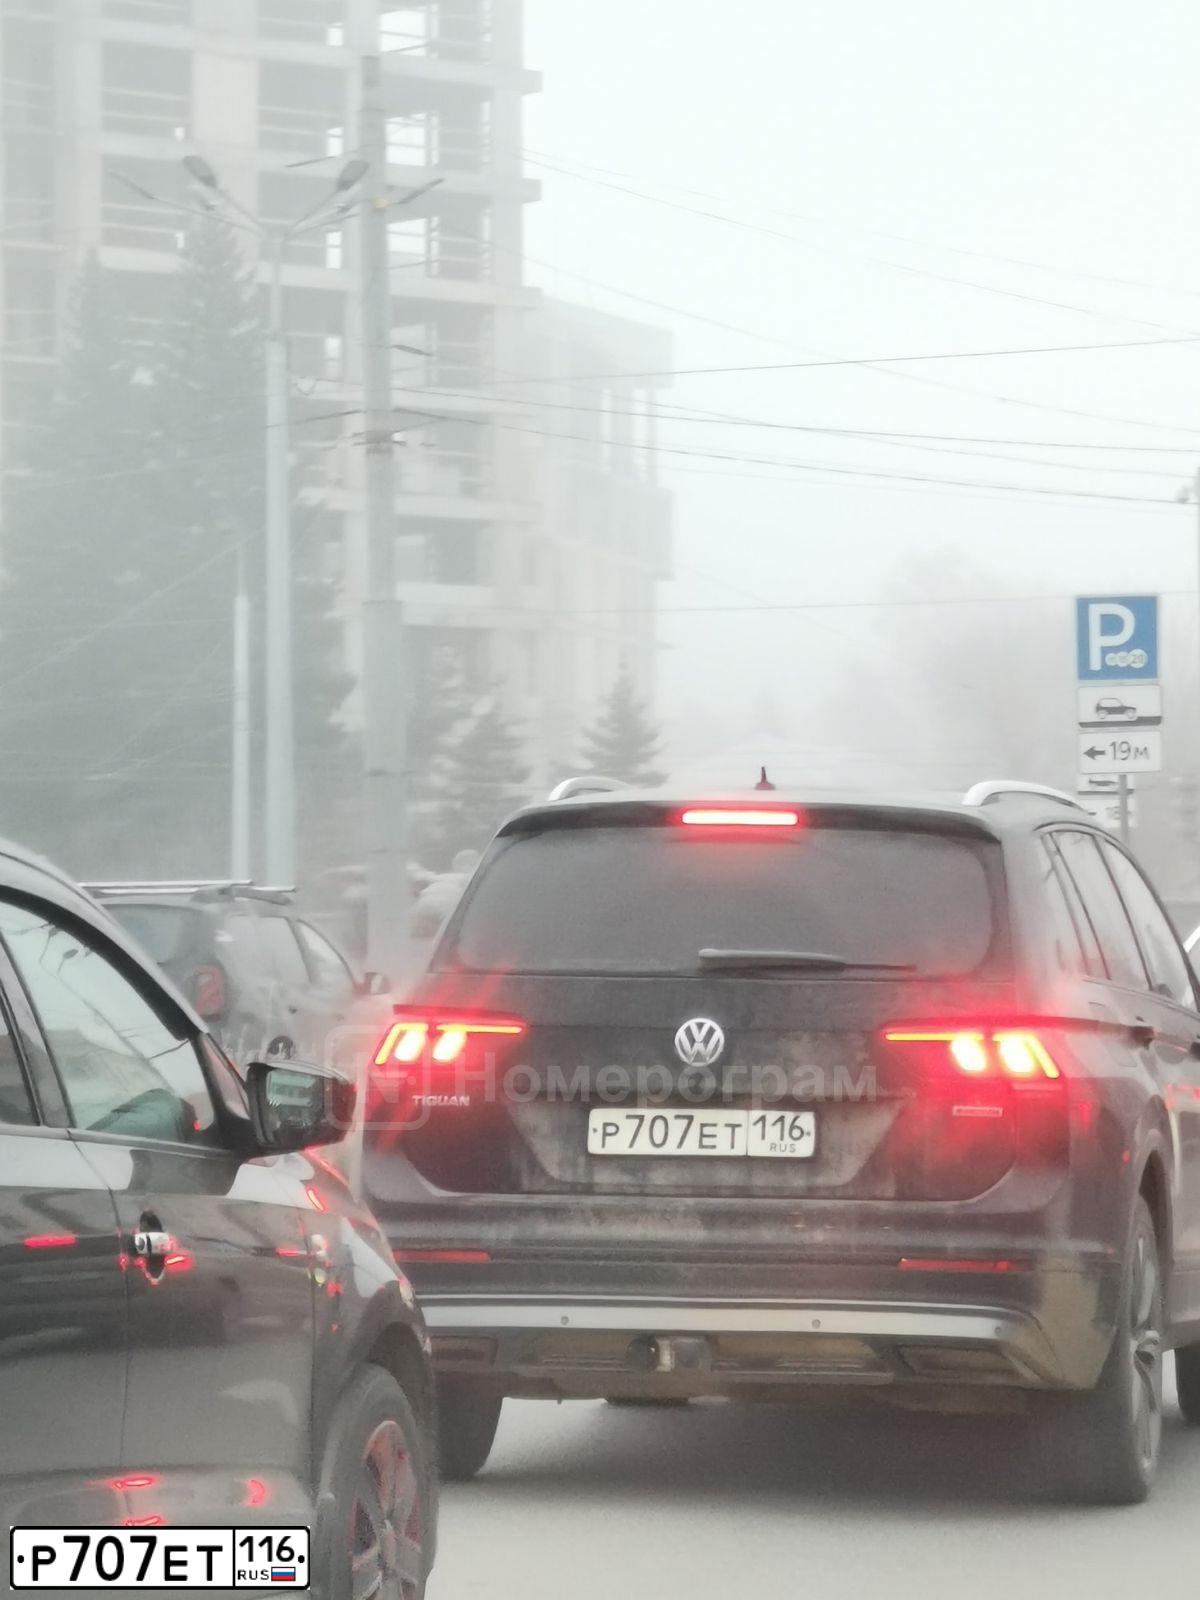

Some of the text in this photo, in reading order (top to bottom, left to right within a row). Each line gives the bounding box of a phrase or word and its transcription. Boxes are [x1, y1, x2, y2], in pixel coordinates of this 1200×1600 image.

[1088, 603, 1136, 671] P
[412, 1094, 470, 1106] TIGUAN
[753, 1114, 805, 1141] 116
[769, 1142, 797, 1153] RUS
